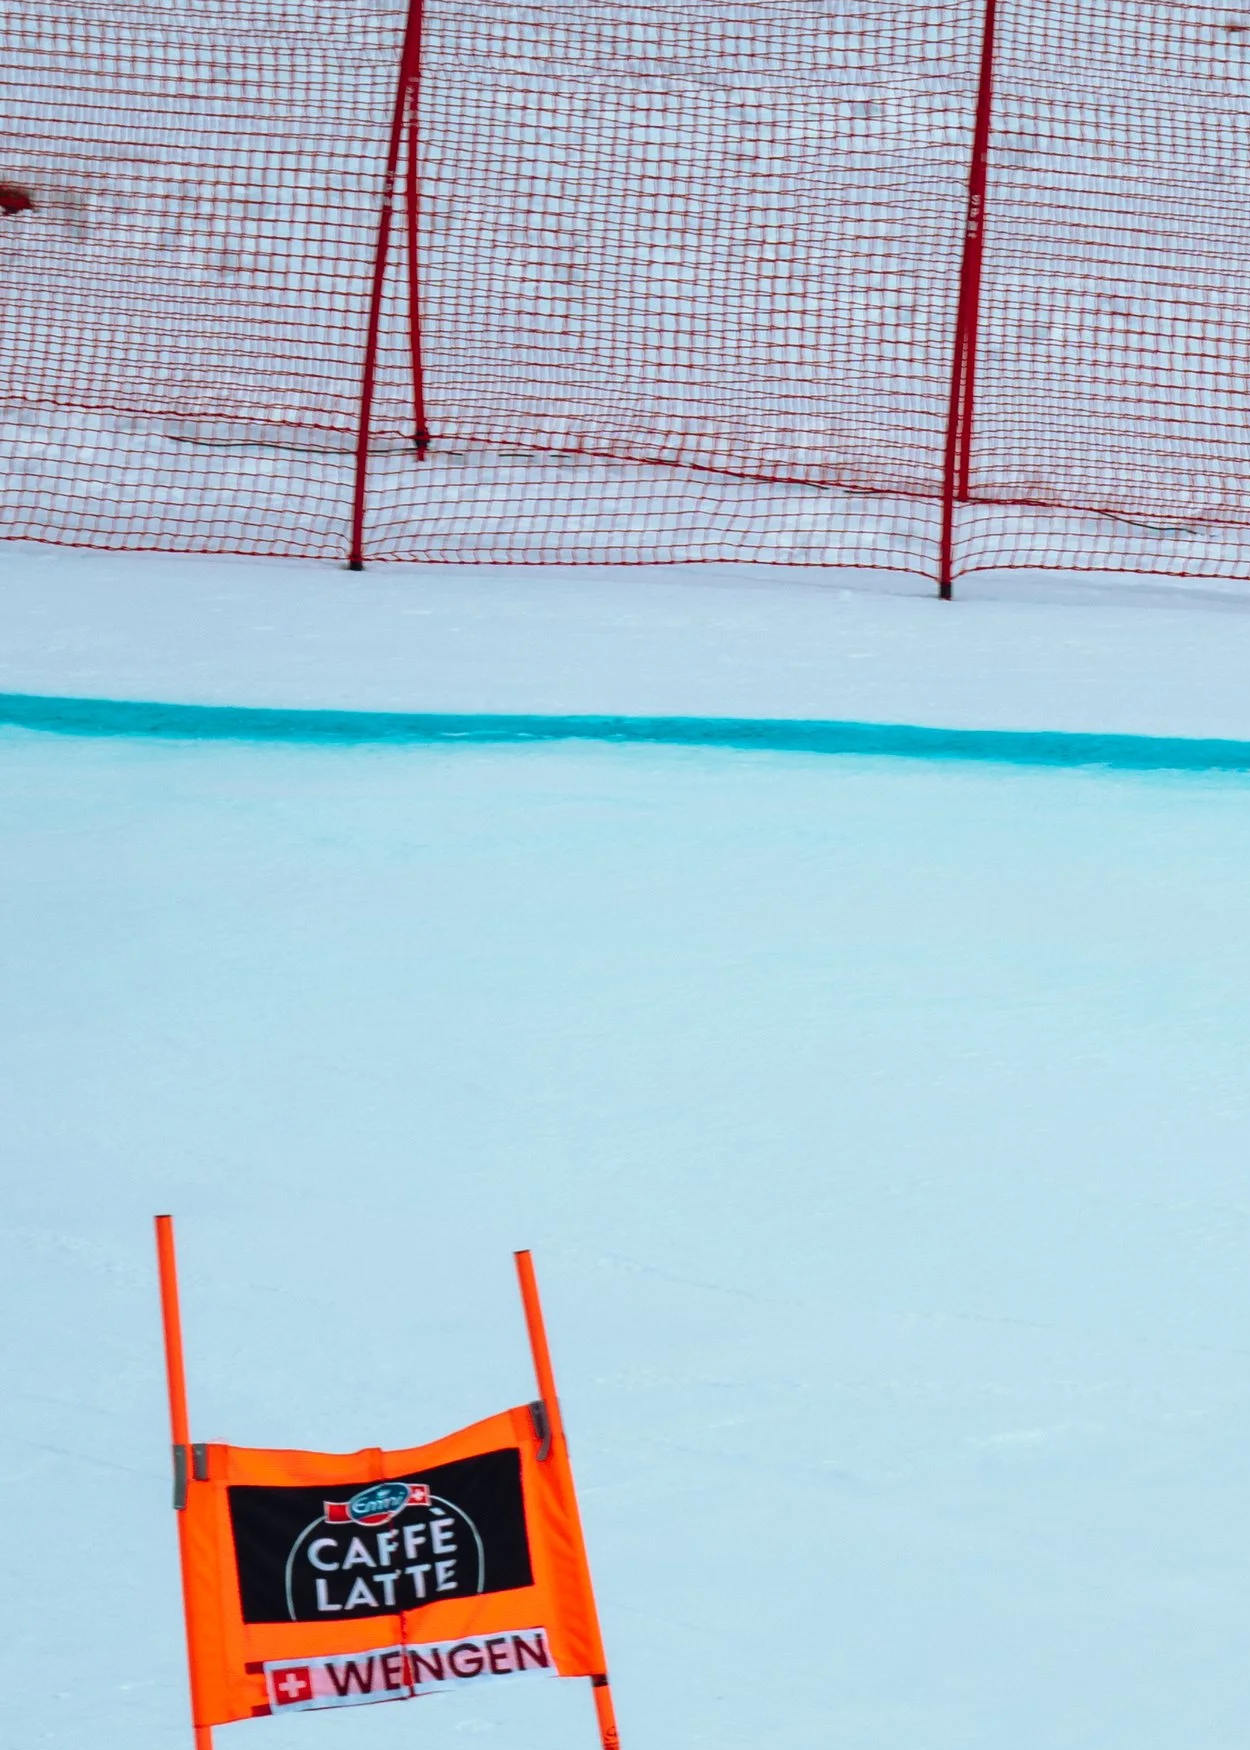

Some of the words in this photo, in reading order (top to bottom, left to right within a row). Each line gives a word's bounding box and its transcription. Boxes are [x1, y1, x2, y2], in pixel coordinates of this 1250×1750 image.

[307, 1507, 459, 1572] CAFFÈ
[315, 1559, 458, 1612] LATTE
[325, 1633, 550, 1697] WENGEN
